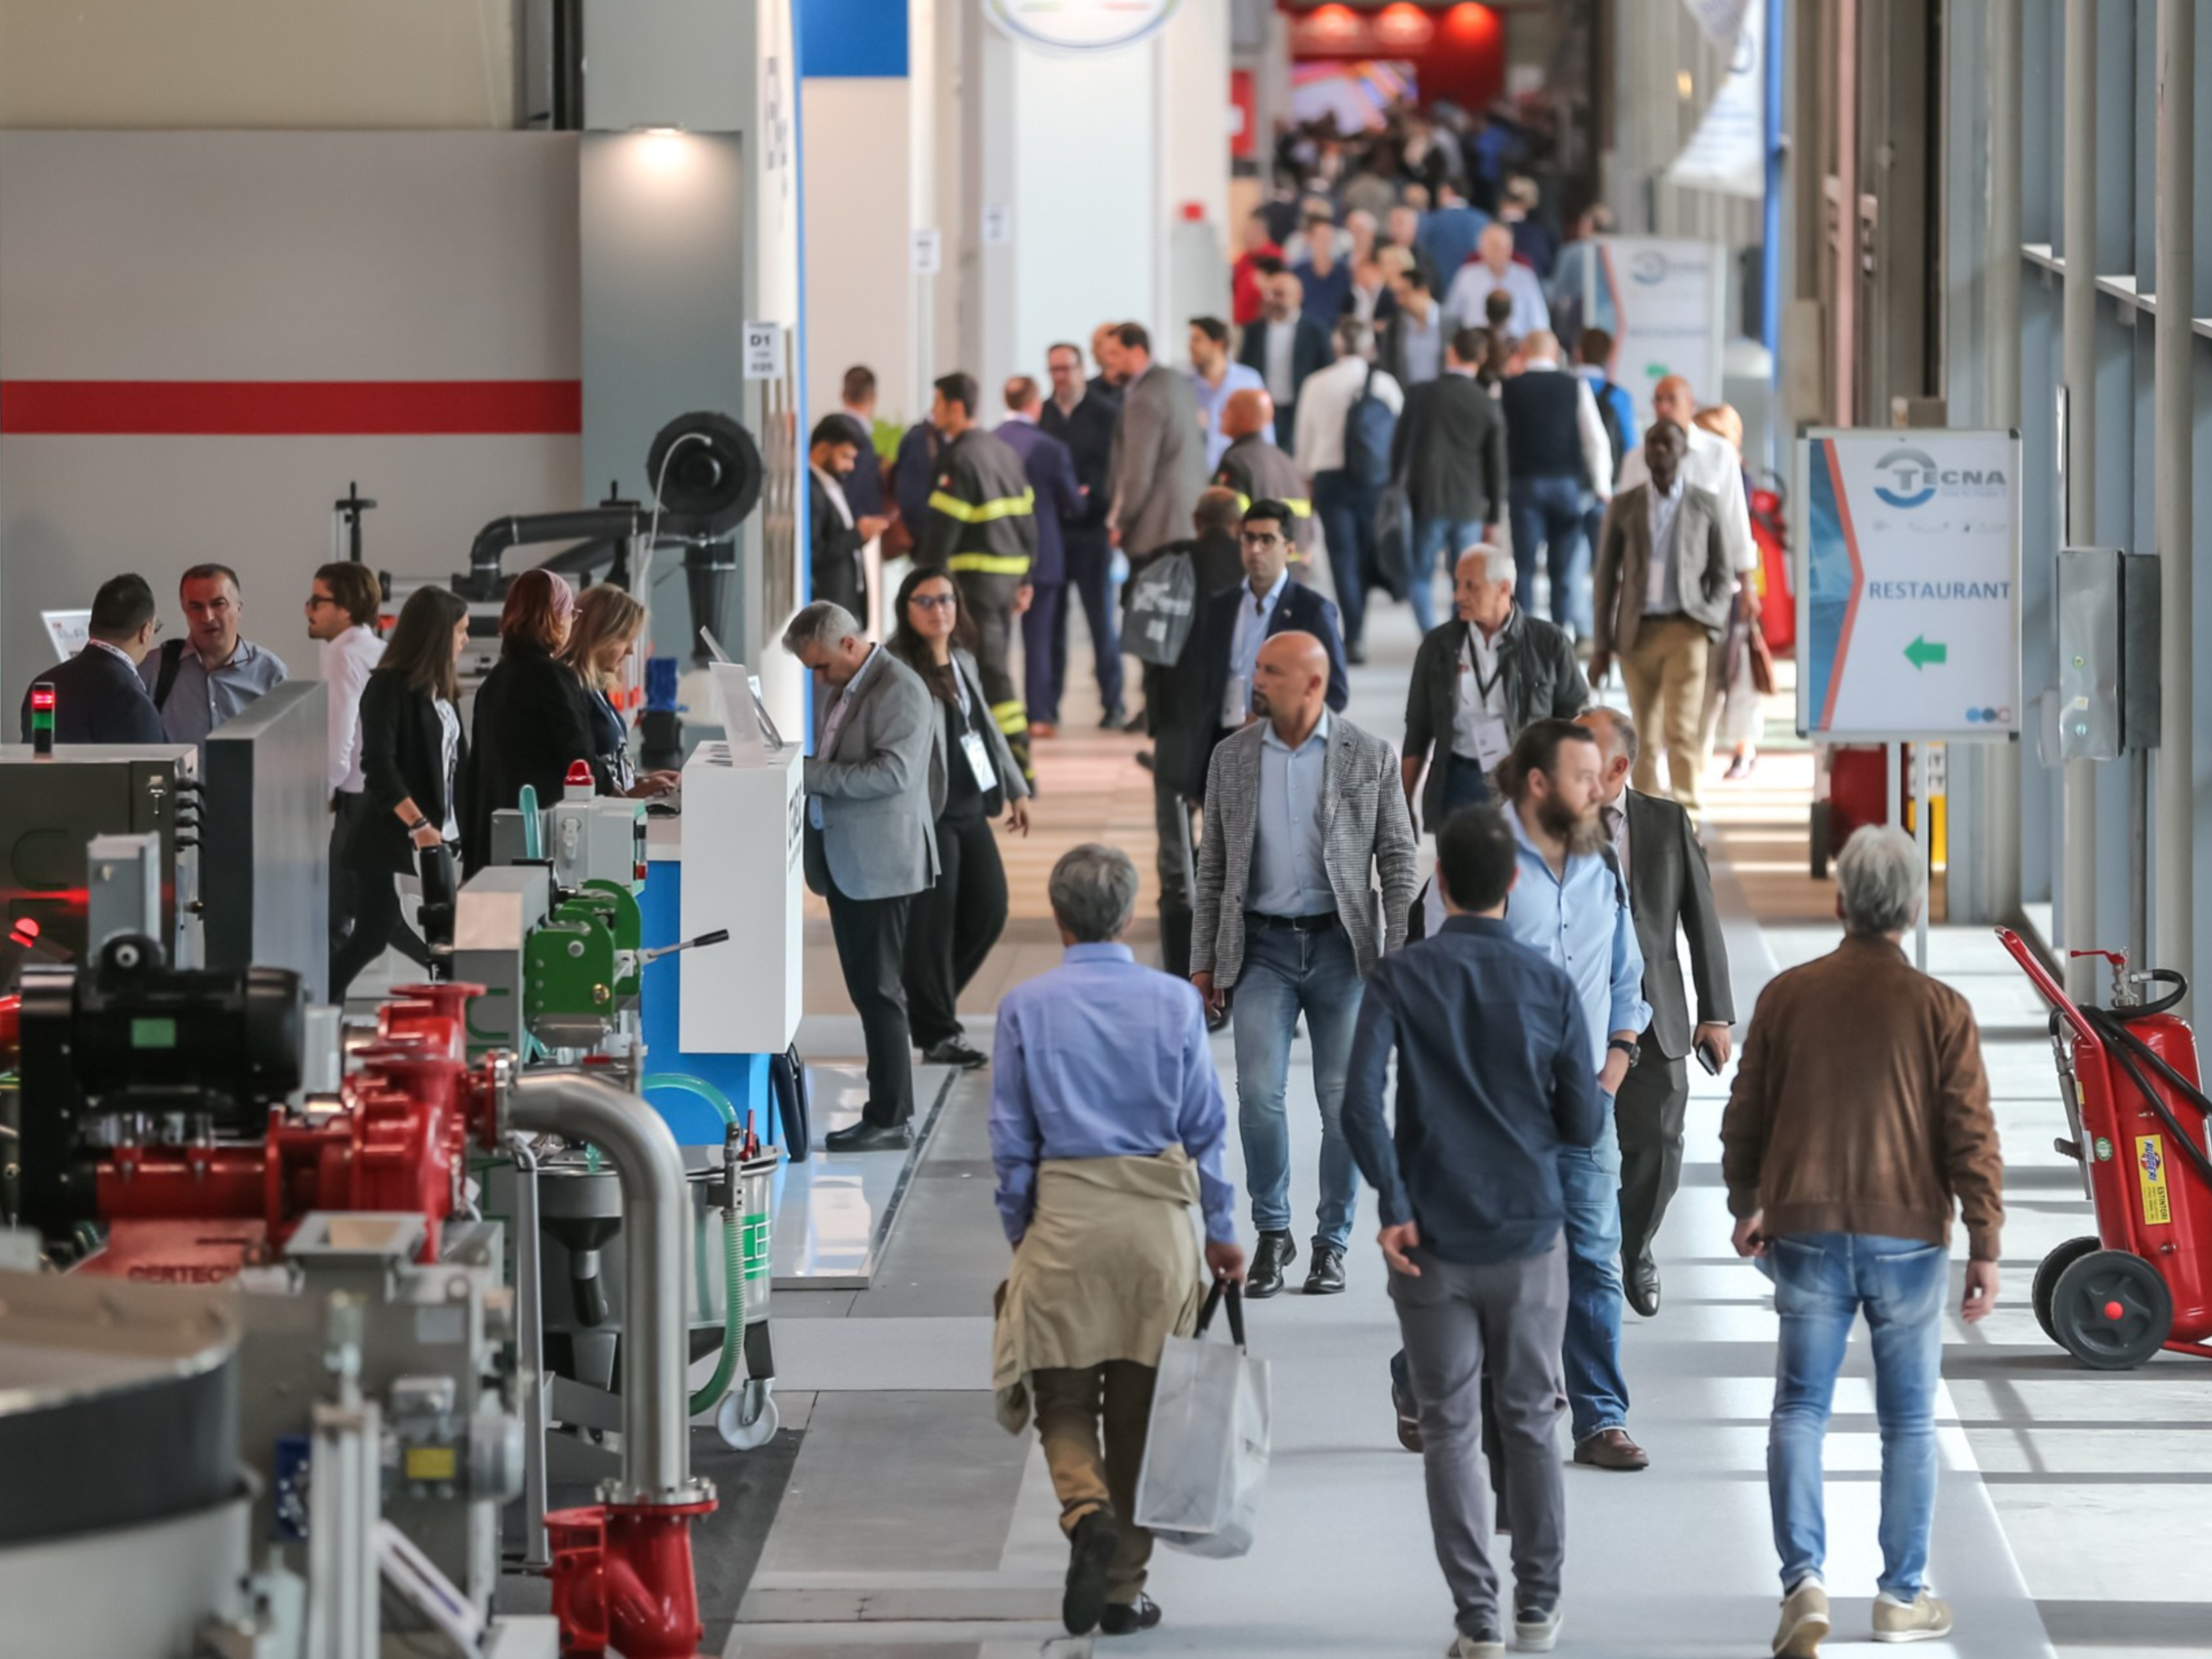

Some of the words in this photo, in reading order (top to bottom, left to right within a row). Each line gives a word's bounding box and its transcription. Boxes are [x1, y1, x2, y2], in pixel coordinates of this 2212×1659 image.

[750, 335, 770, 346] D1
[1892, 469, 2006, 490] TECNA
[1868, 581, 2011, 600] RESTAURANT
[2157, 1186, 2168, 1221] ESTINTORI
